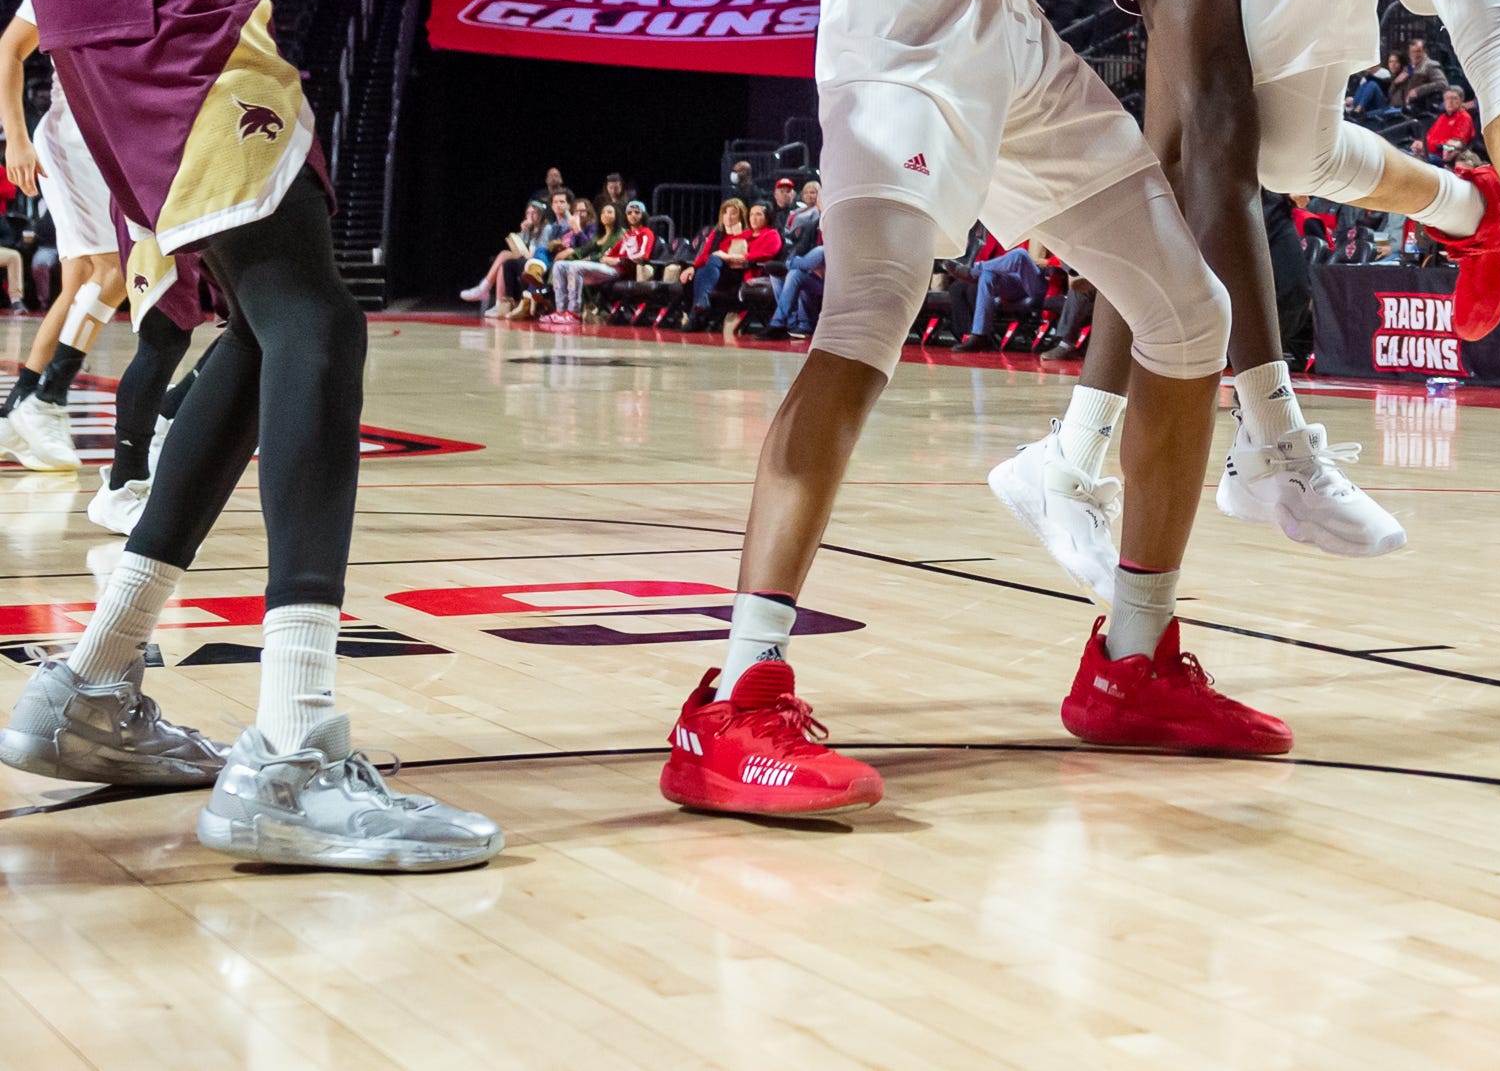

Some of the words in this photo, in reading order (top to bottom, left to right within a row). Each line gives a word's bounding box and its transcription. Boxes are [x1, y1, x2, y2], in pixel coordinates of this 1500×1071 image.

[476, 0, 820, 37] CAJUNS
[903, 162, 930, 176] adidas
[1376, 335, 1459, 371] CAJUNS
